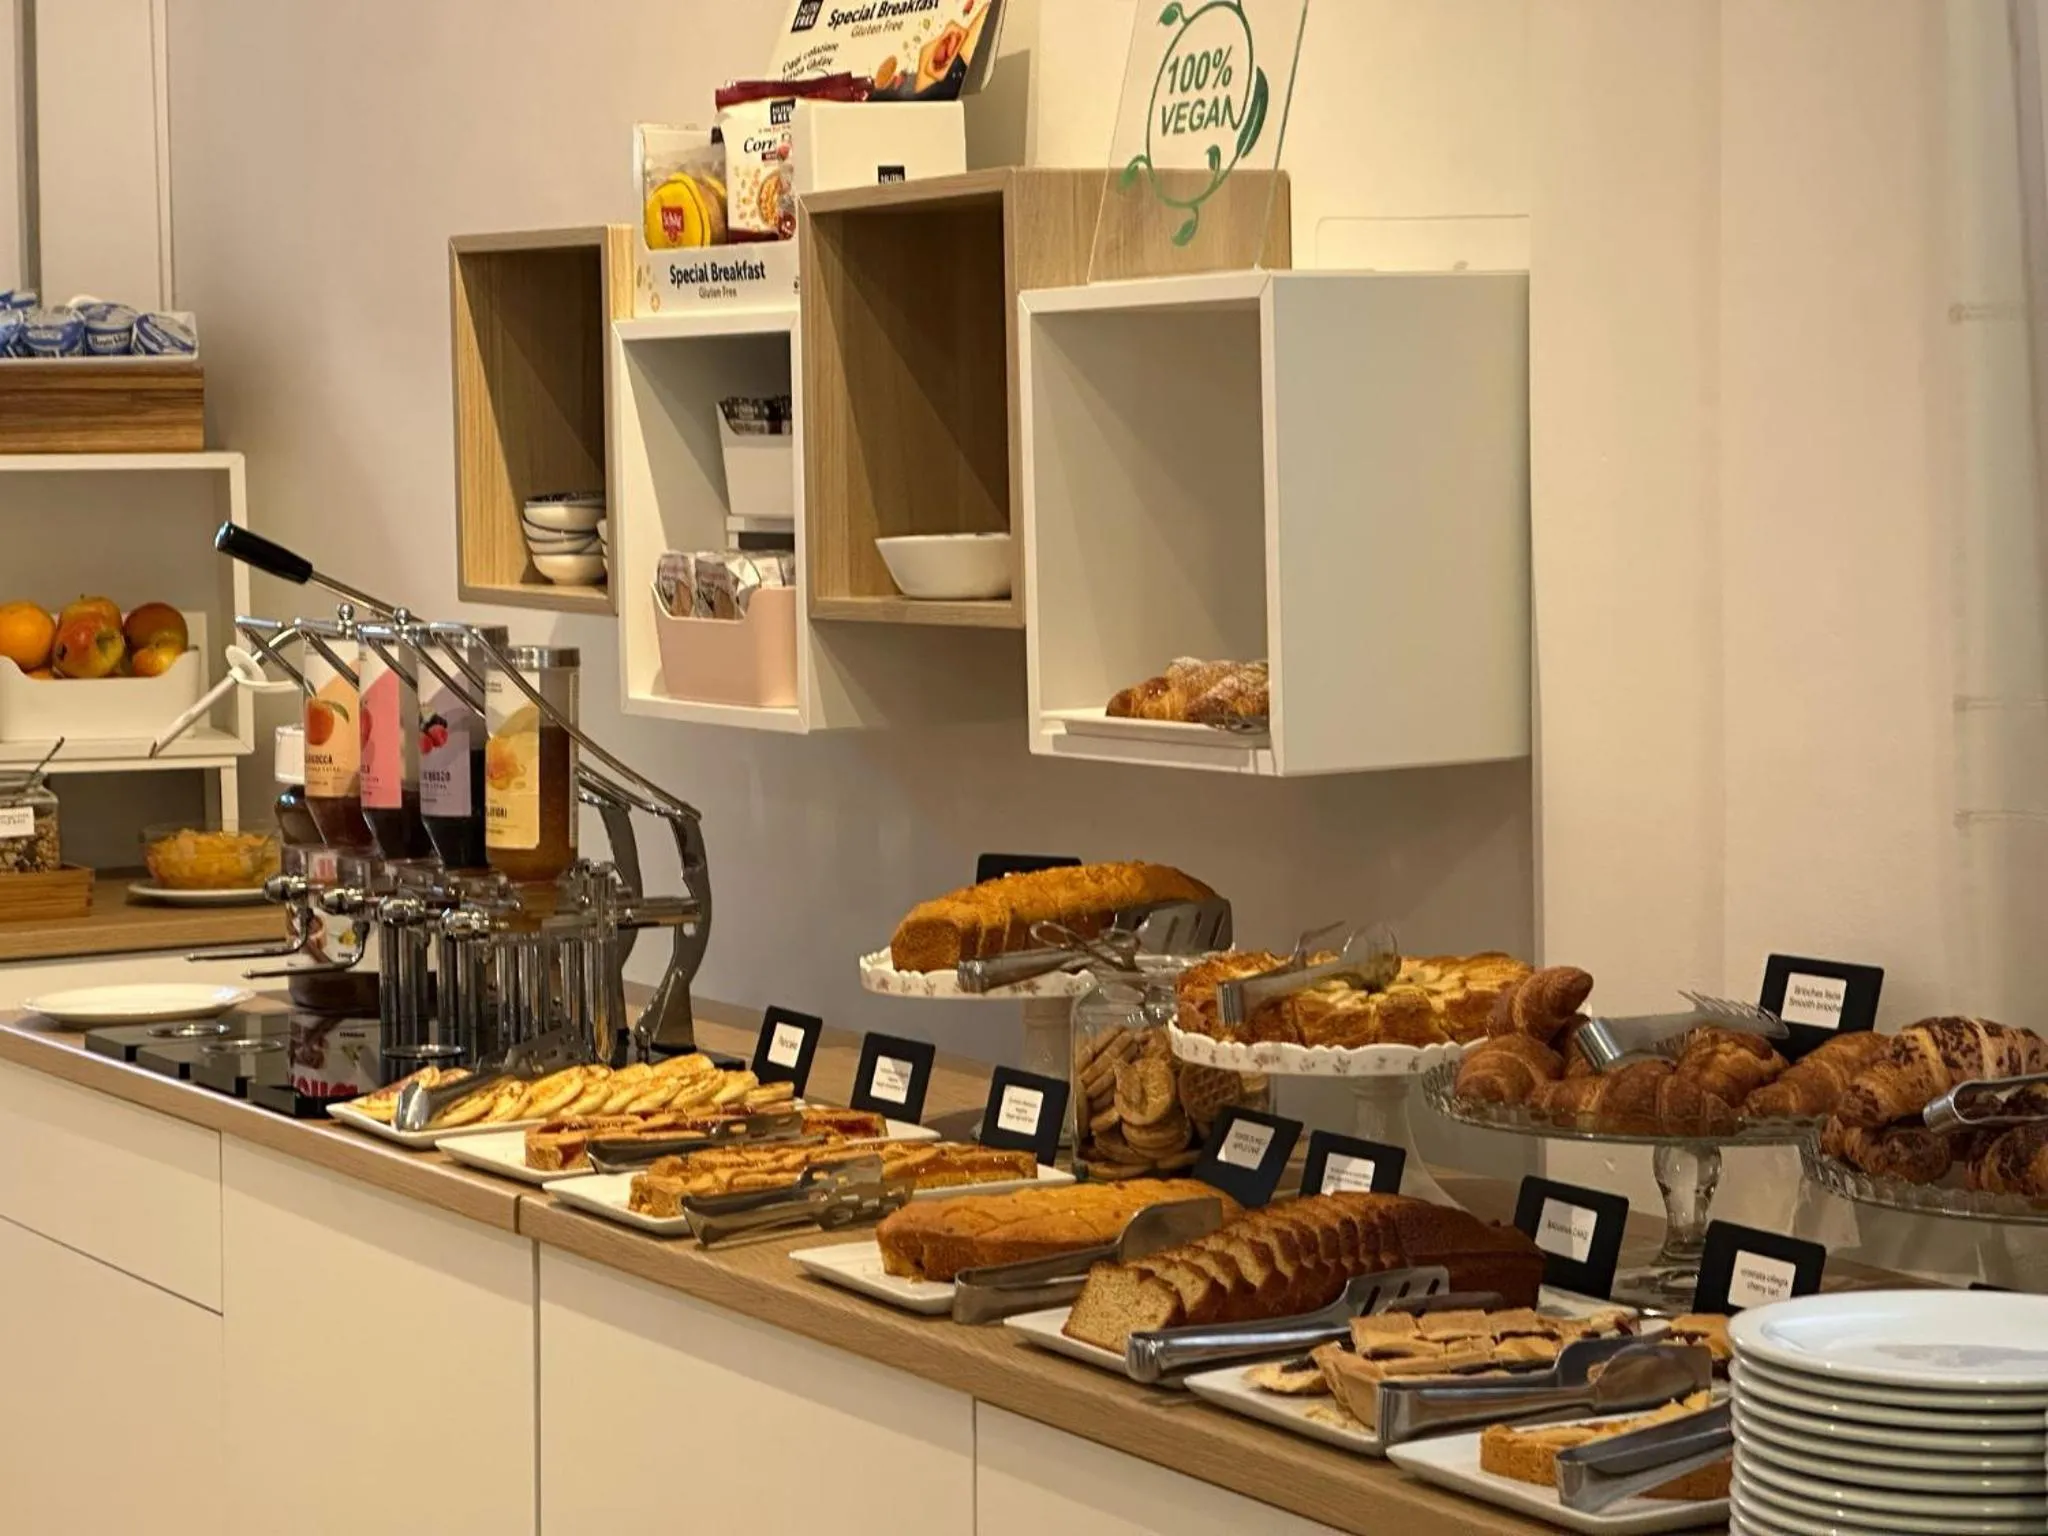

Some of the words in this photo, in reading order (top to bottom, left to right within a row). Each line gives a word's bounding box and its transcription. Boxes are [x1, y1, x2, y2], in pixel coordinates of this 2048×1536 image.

[828, 3, 875, 30] Special
[877, 0, 939, 17] Breakfast
[851, 22, 882, 38] Gluten
[883, 19, 904, 32] Free
[1167, 45, 1233, 95] 100%
[1161, 95, 1241, 136] VEGAN
[670, 261, 709, 289] Special
[711, 259, 765, 282] Breakfast
[699, 287, 721, 299] Gluten
[722, 286, 737, 297] Free
[1789, 997, 1815, 1010] Smooth
